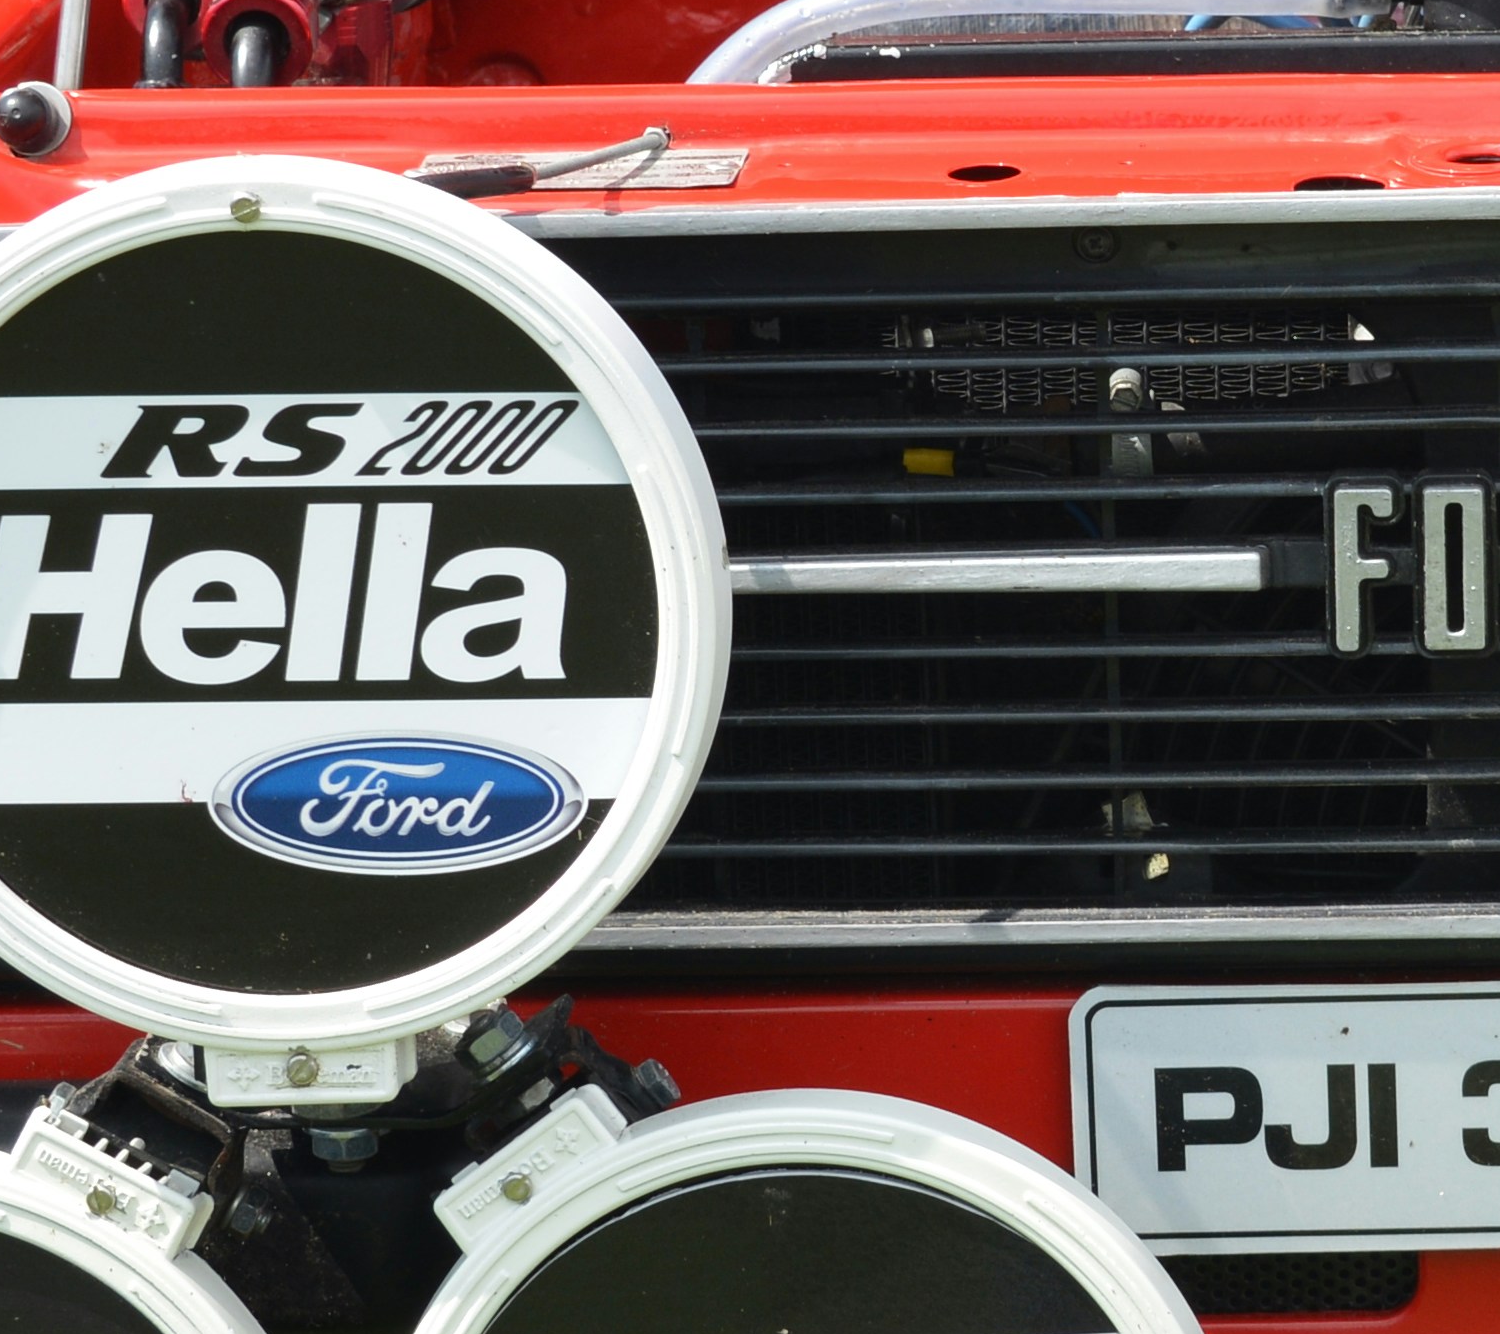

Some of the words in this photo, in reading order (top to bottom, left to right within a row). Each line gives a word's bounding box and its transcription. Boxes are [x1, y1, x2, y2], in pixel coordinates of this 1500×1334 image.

[101, 403, 364, 479] RS
[357, 399, 579, 477] 2000
[300, 758, 496, 839] Ford
[1155, 1063, 1400, 1172] PJI
